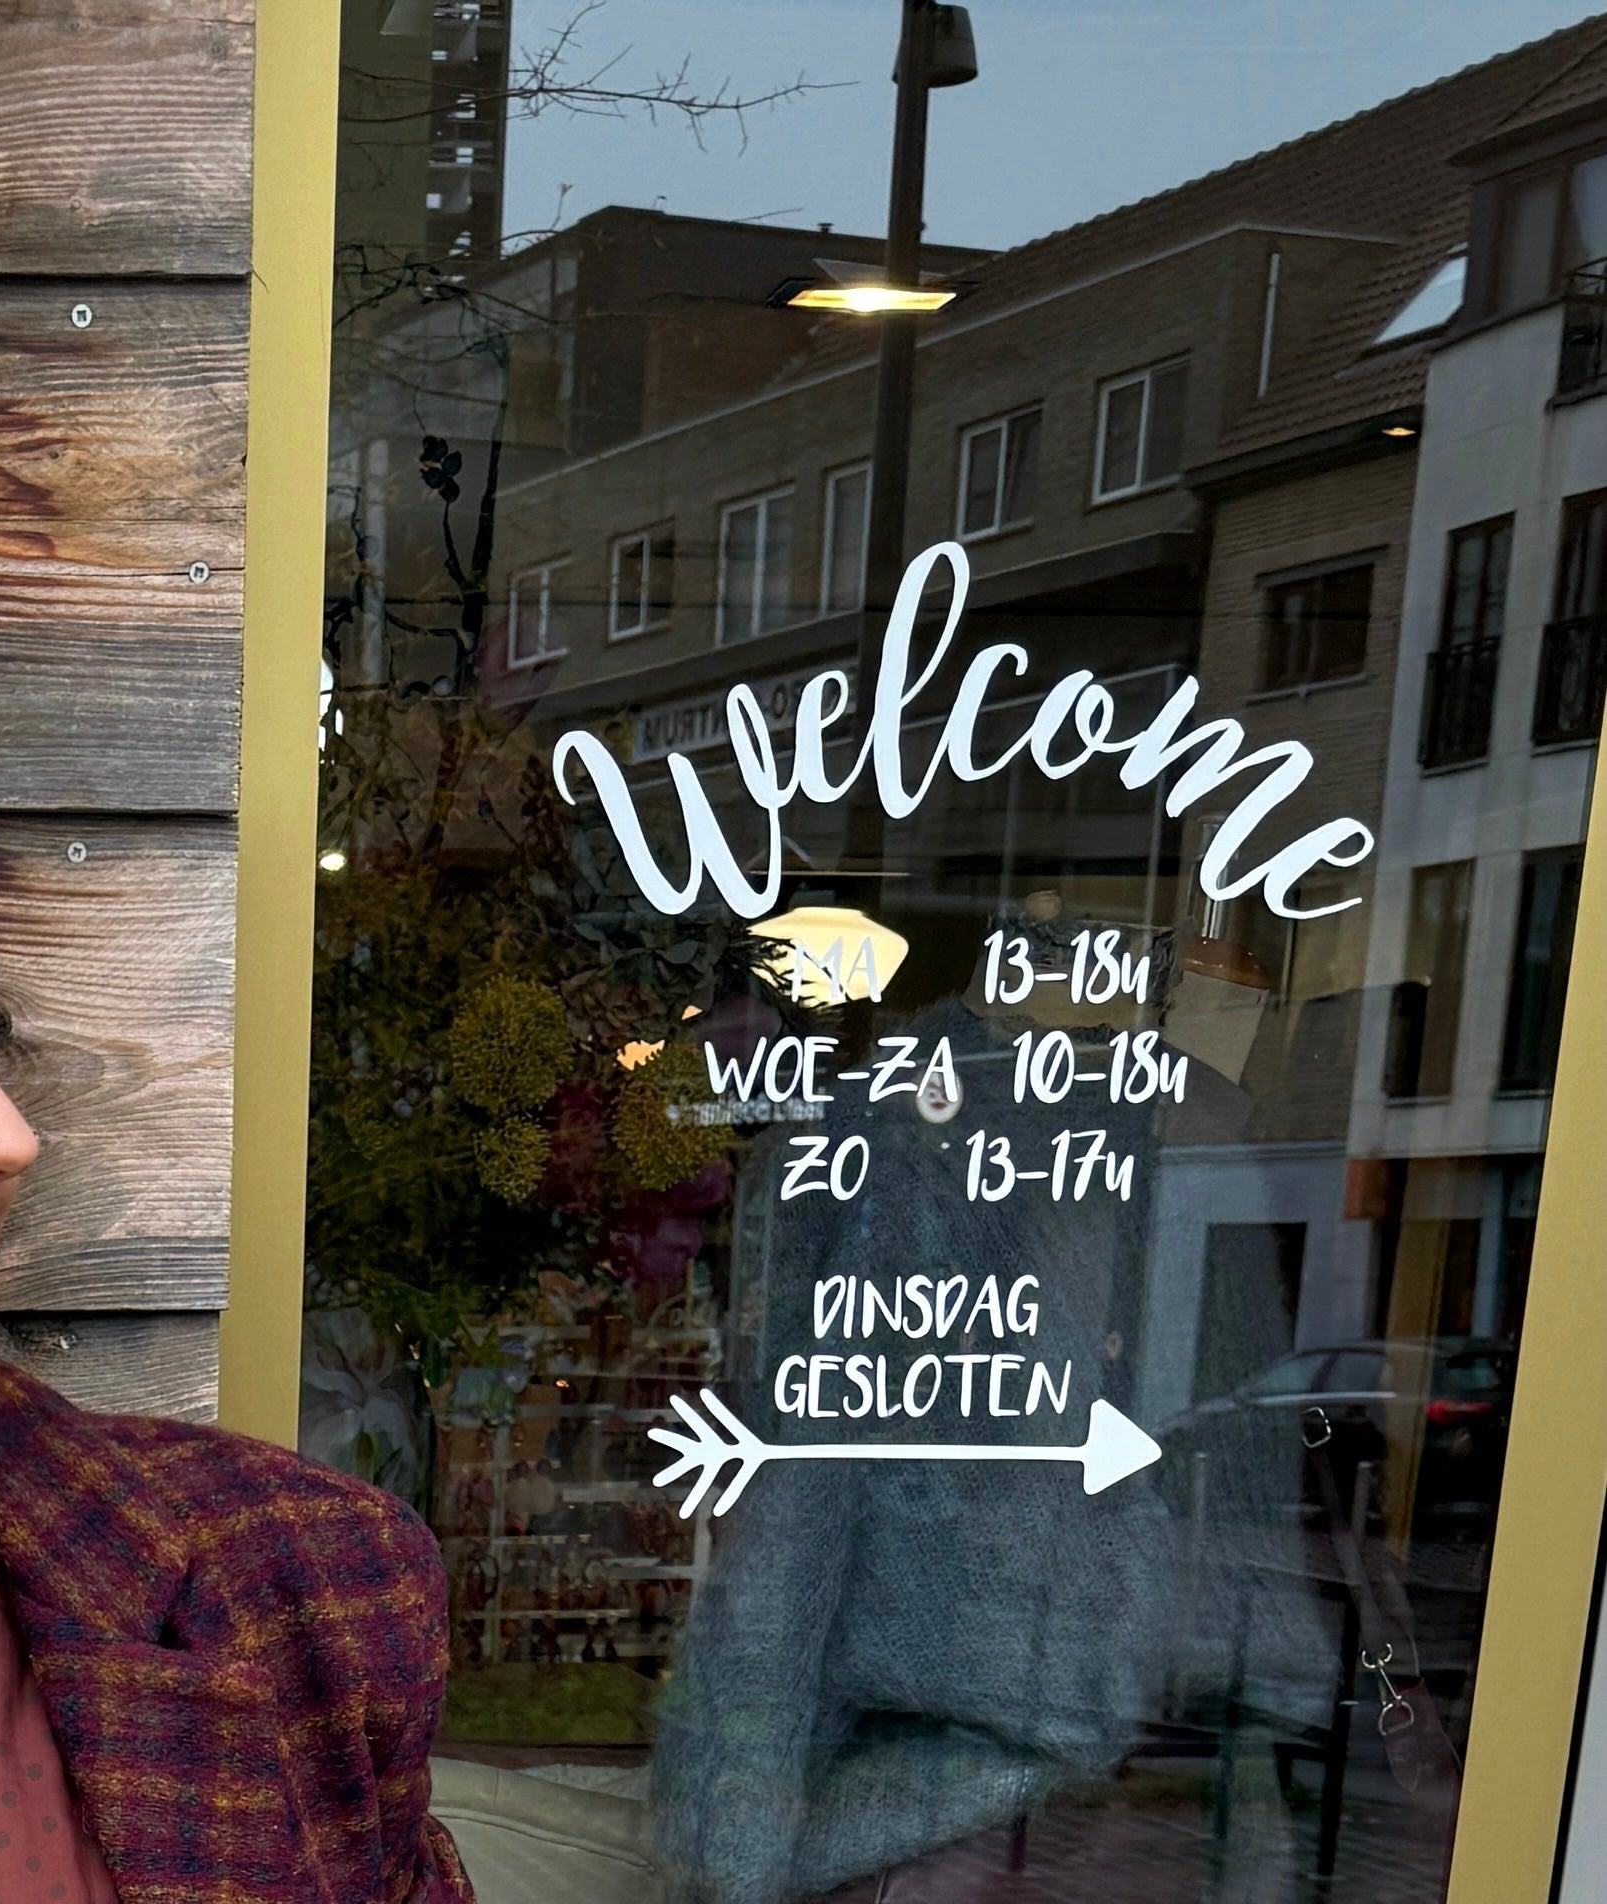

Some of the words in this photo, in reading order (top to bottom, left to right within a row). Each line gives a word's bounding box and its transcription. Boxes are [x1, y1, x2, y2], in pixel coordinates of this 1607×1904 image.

[552, 541, 1375, 920] Welcome
[791, 936, 883, 1003] MA
[983, 929, 1150, 1005] 13-18u
[703, 1036, 959, 1103] WOE-ZA
[1012, 1029, 1189, 1104] 10-18u
[780, 1135, 870, 1202] ZO
[965, 1129, 1135, 1202] 13-17u
[812, 1273, 1040, 1339] DINSDAG
[774, 1353, 1073, 1419] GESLOTEN
